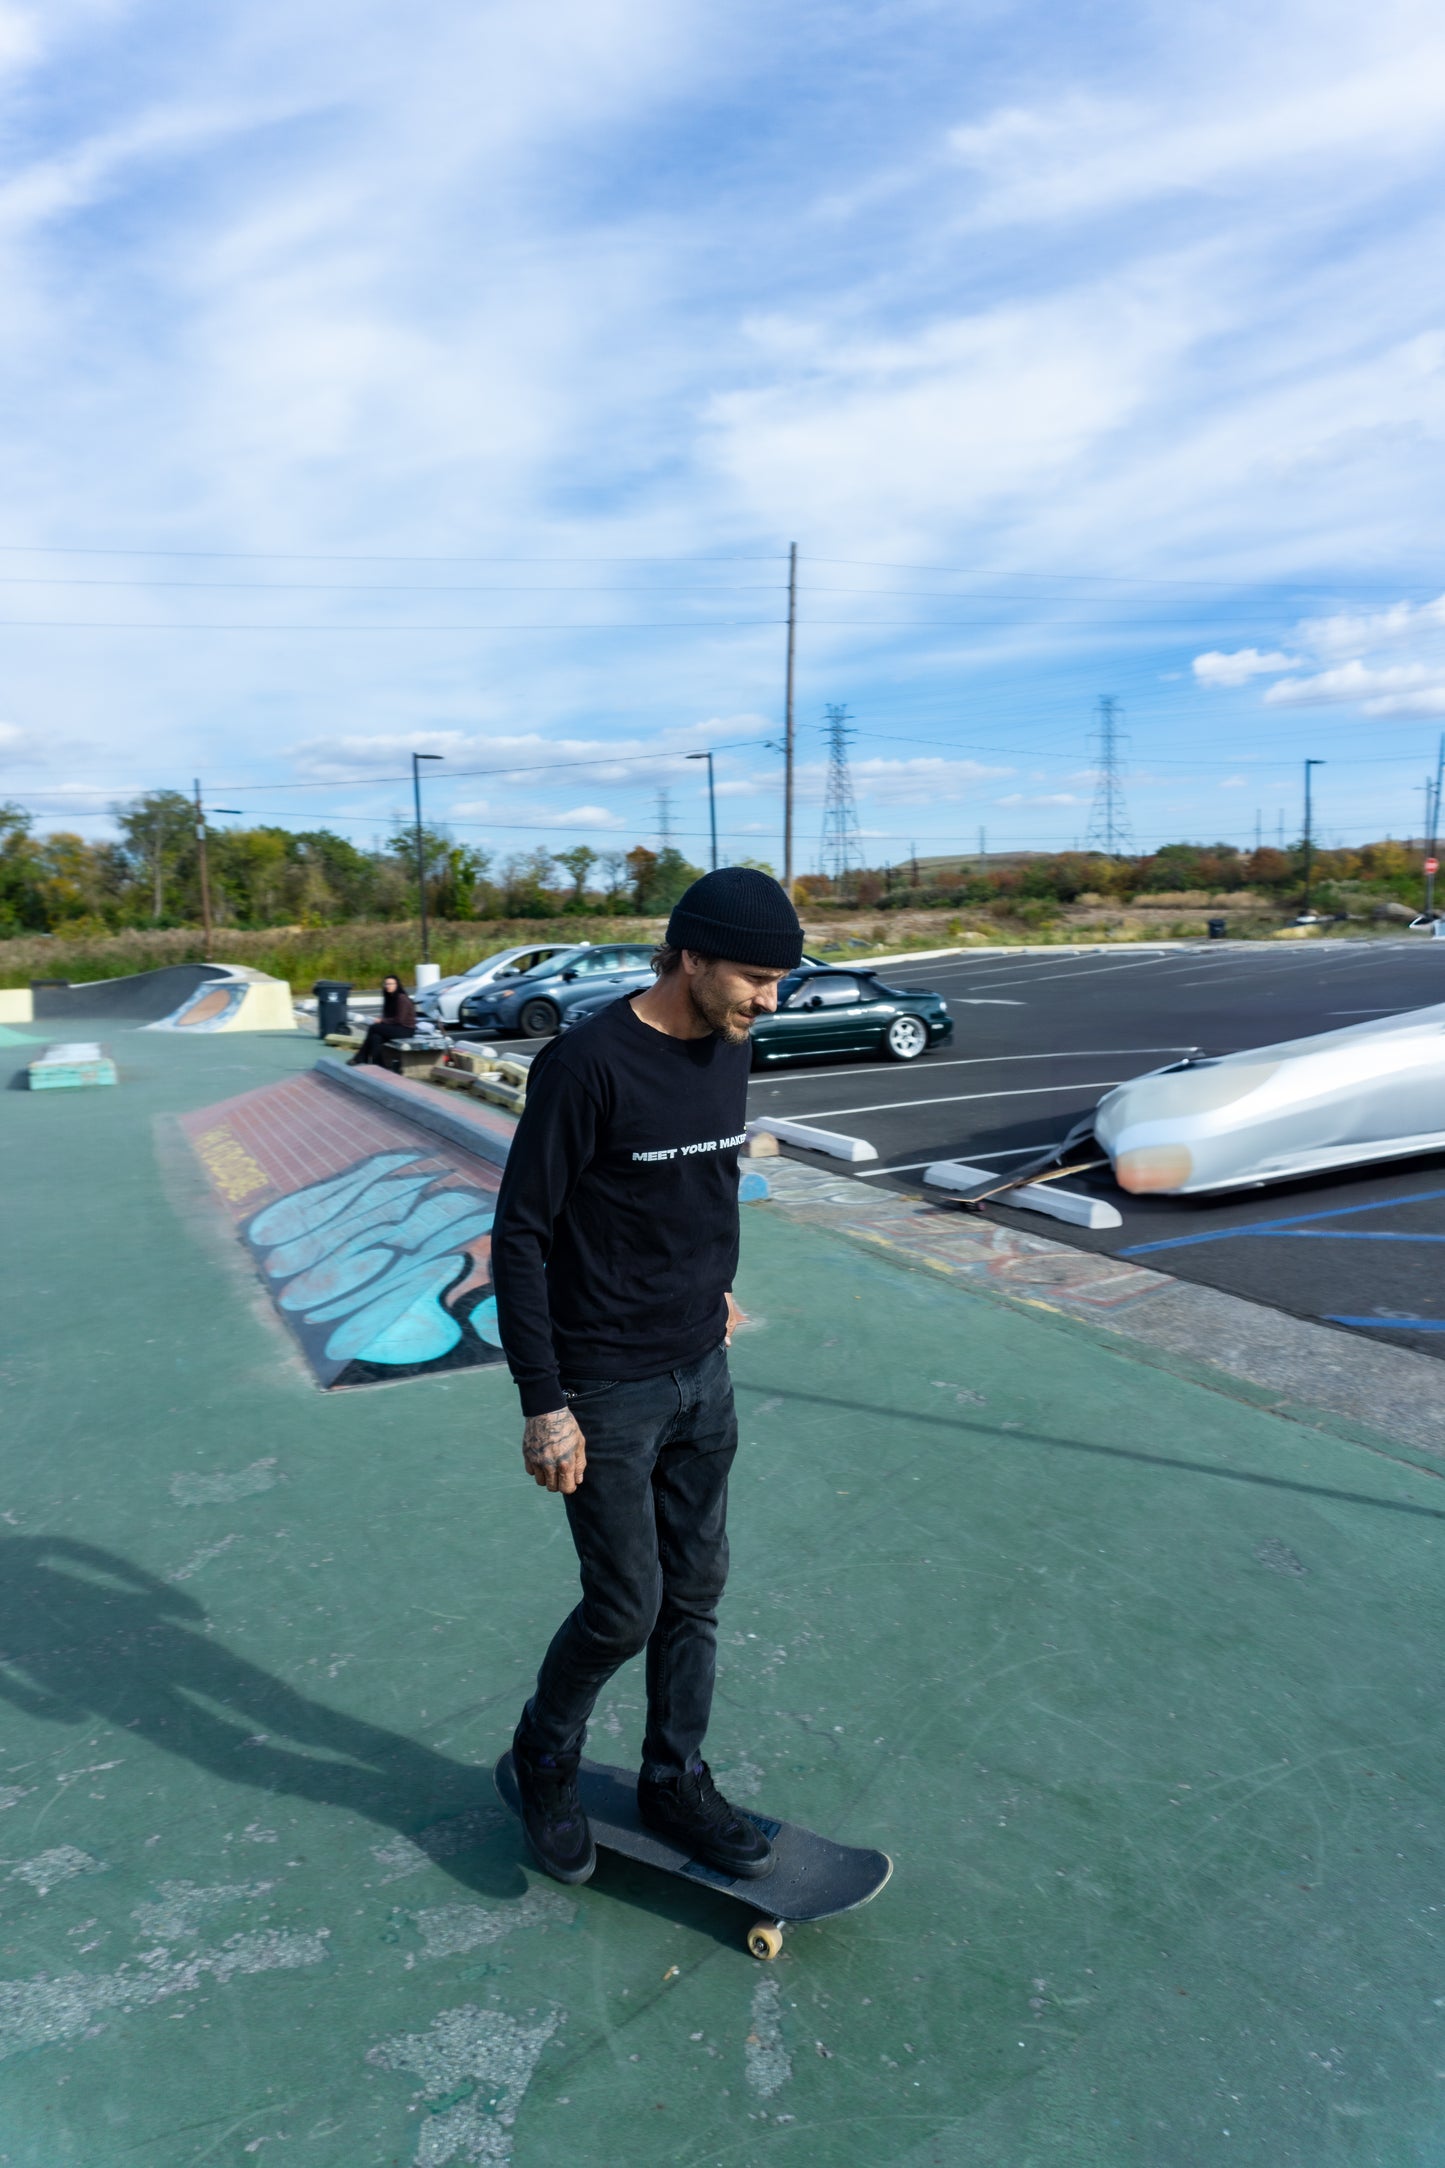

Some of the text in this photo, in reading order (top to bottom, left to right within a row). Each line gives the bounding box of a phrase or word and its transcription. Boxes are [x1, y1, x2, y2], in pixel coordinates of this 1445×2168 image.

[632, 1133, 746, 1161] MEET YOUR MAKE
